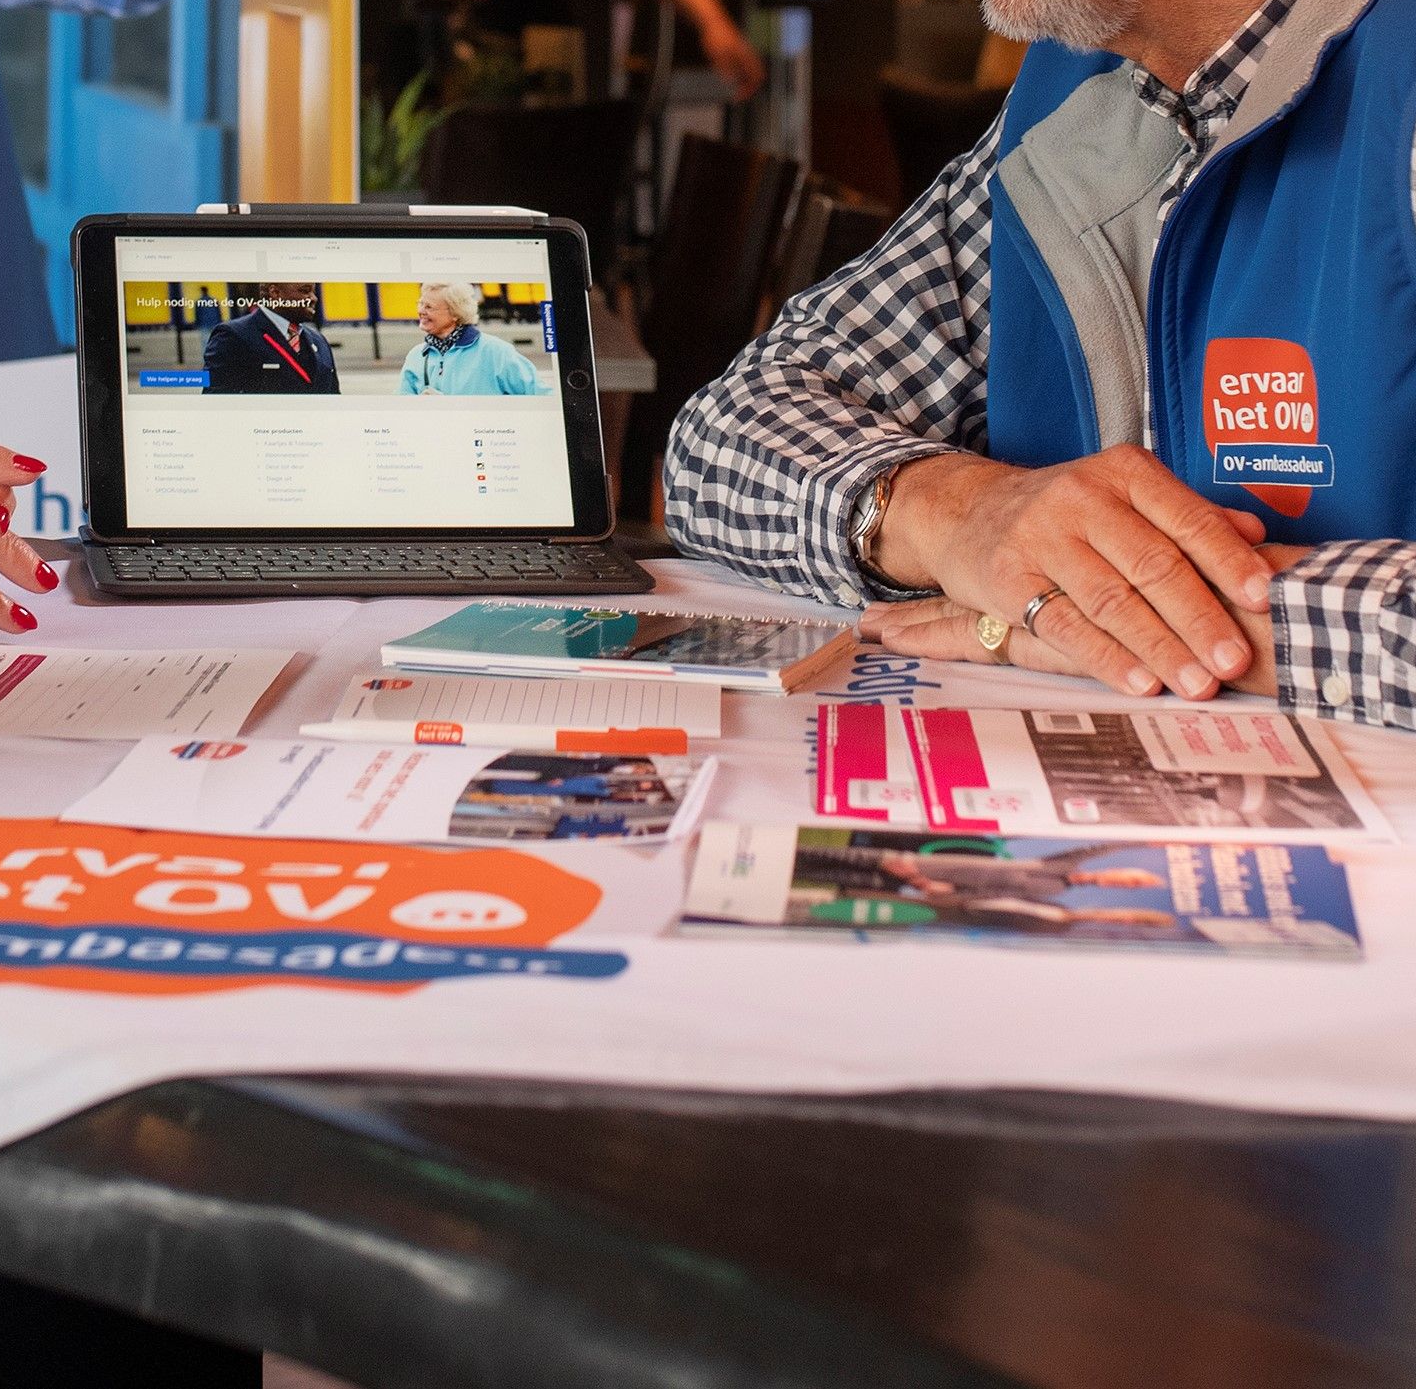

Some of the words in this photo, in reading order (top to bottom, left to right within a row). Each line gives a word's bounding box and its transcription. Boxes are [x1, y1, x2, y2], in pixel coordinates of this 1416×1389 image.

[136, 297, 162, 308] Hulp
[164, 297, 194, 309] nodig
[197, 298, 218, 307] met
[221, 297, 234, 307] de
[236, 297, 312, 309] OV-chipkaart?
[1220, 371, 1305, 396] ervaar
[1213, 398, 1270, 430] het
[133, 878, 376, 921] OV
